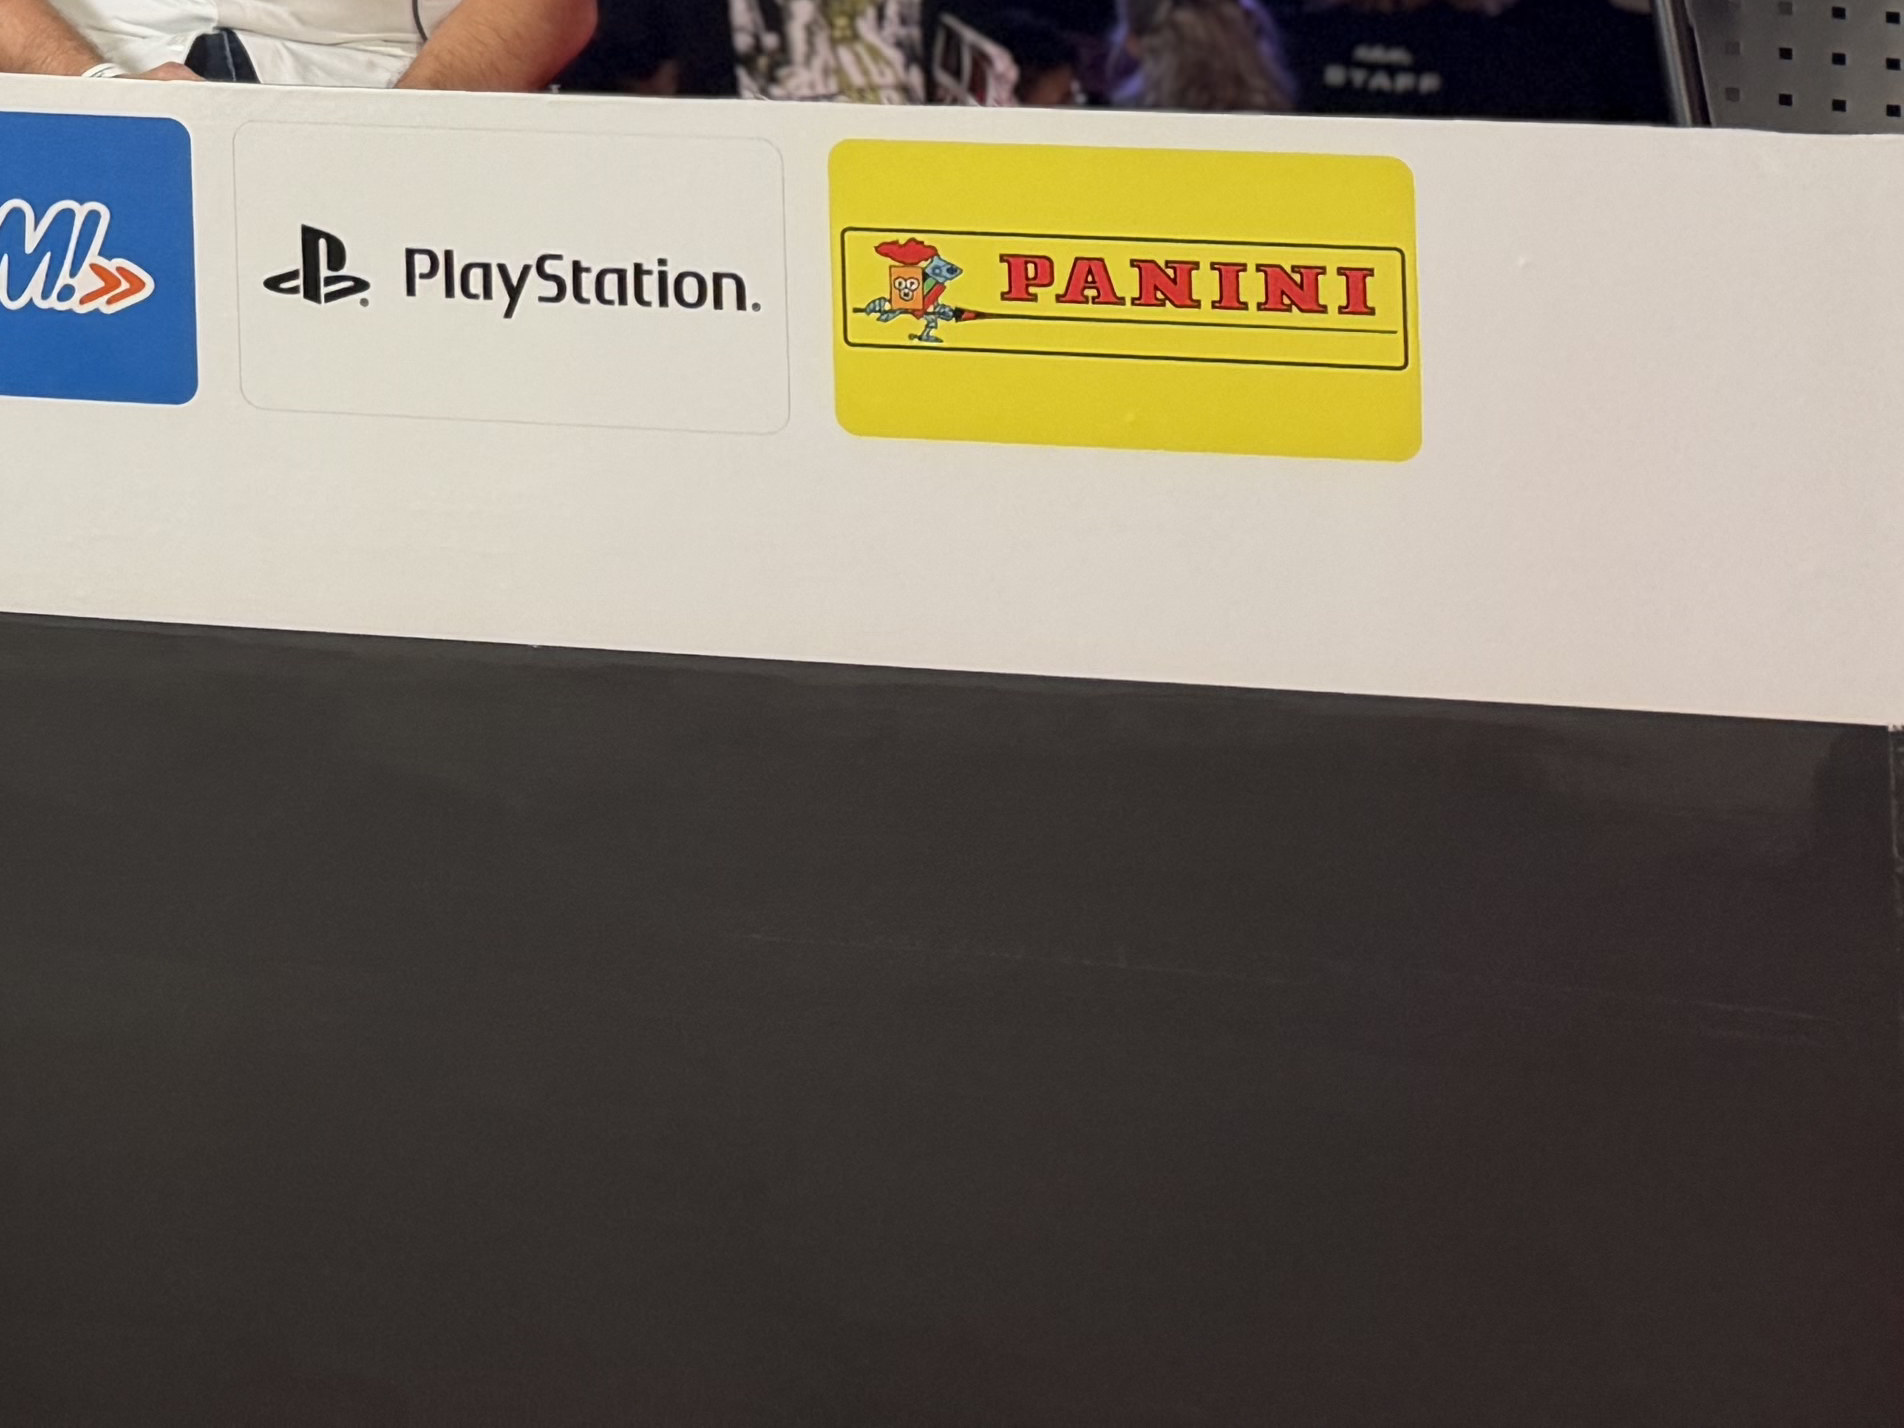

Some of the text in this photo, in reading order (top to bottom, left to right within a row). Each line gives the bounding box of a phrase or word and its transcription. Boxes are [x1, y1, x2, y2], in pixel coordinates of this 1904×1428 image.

[1322, 63, 1442, 94] STAFF
[404, 246, 748, 319] PlayStation
[999, 253, 1376, 316] PANINI
